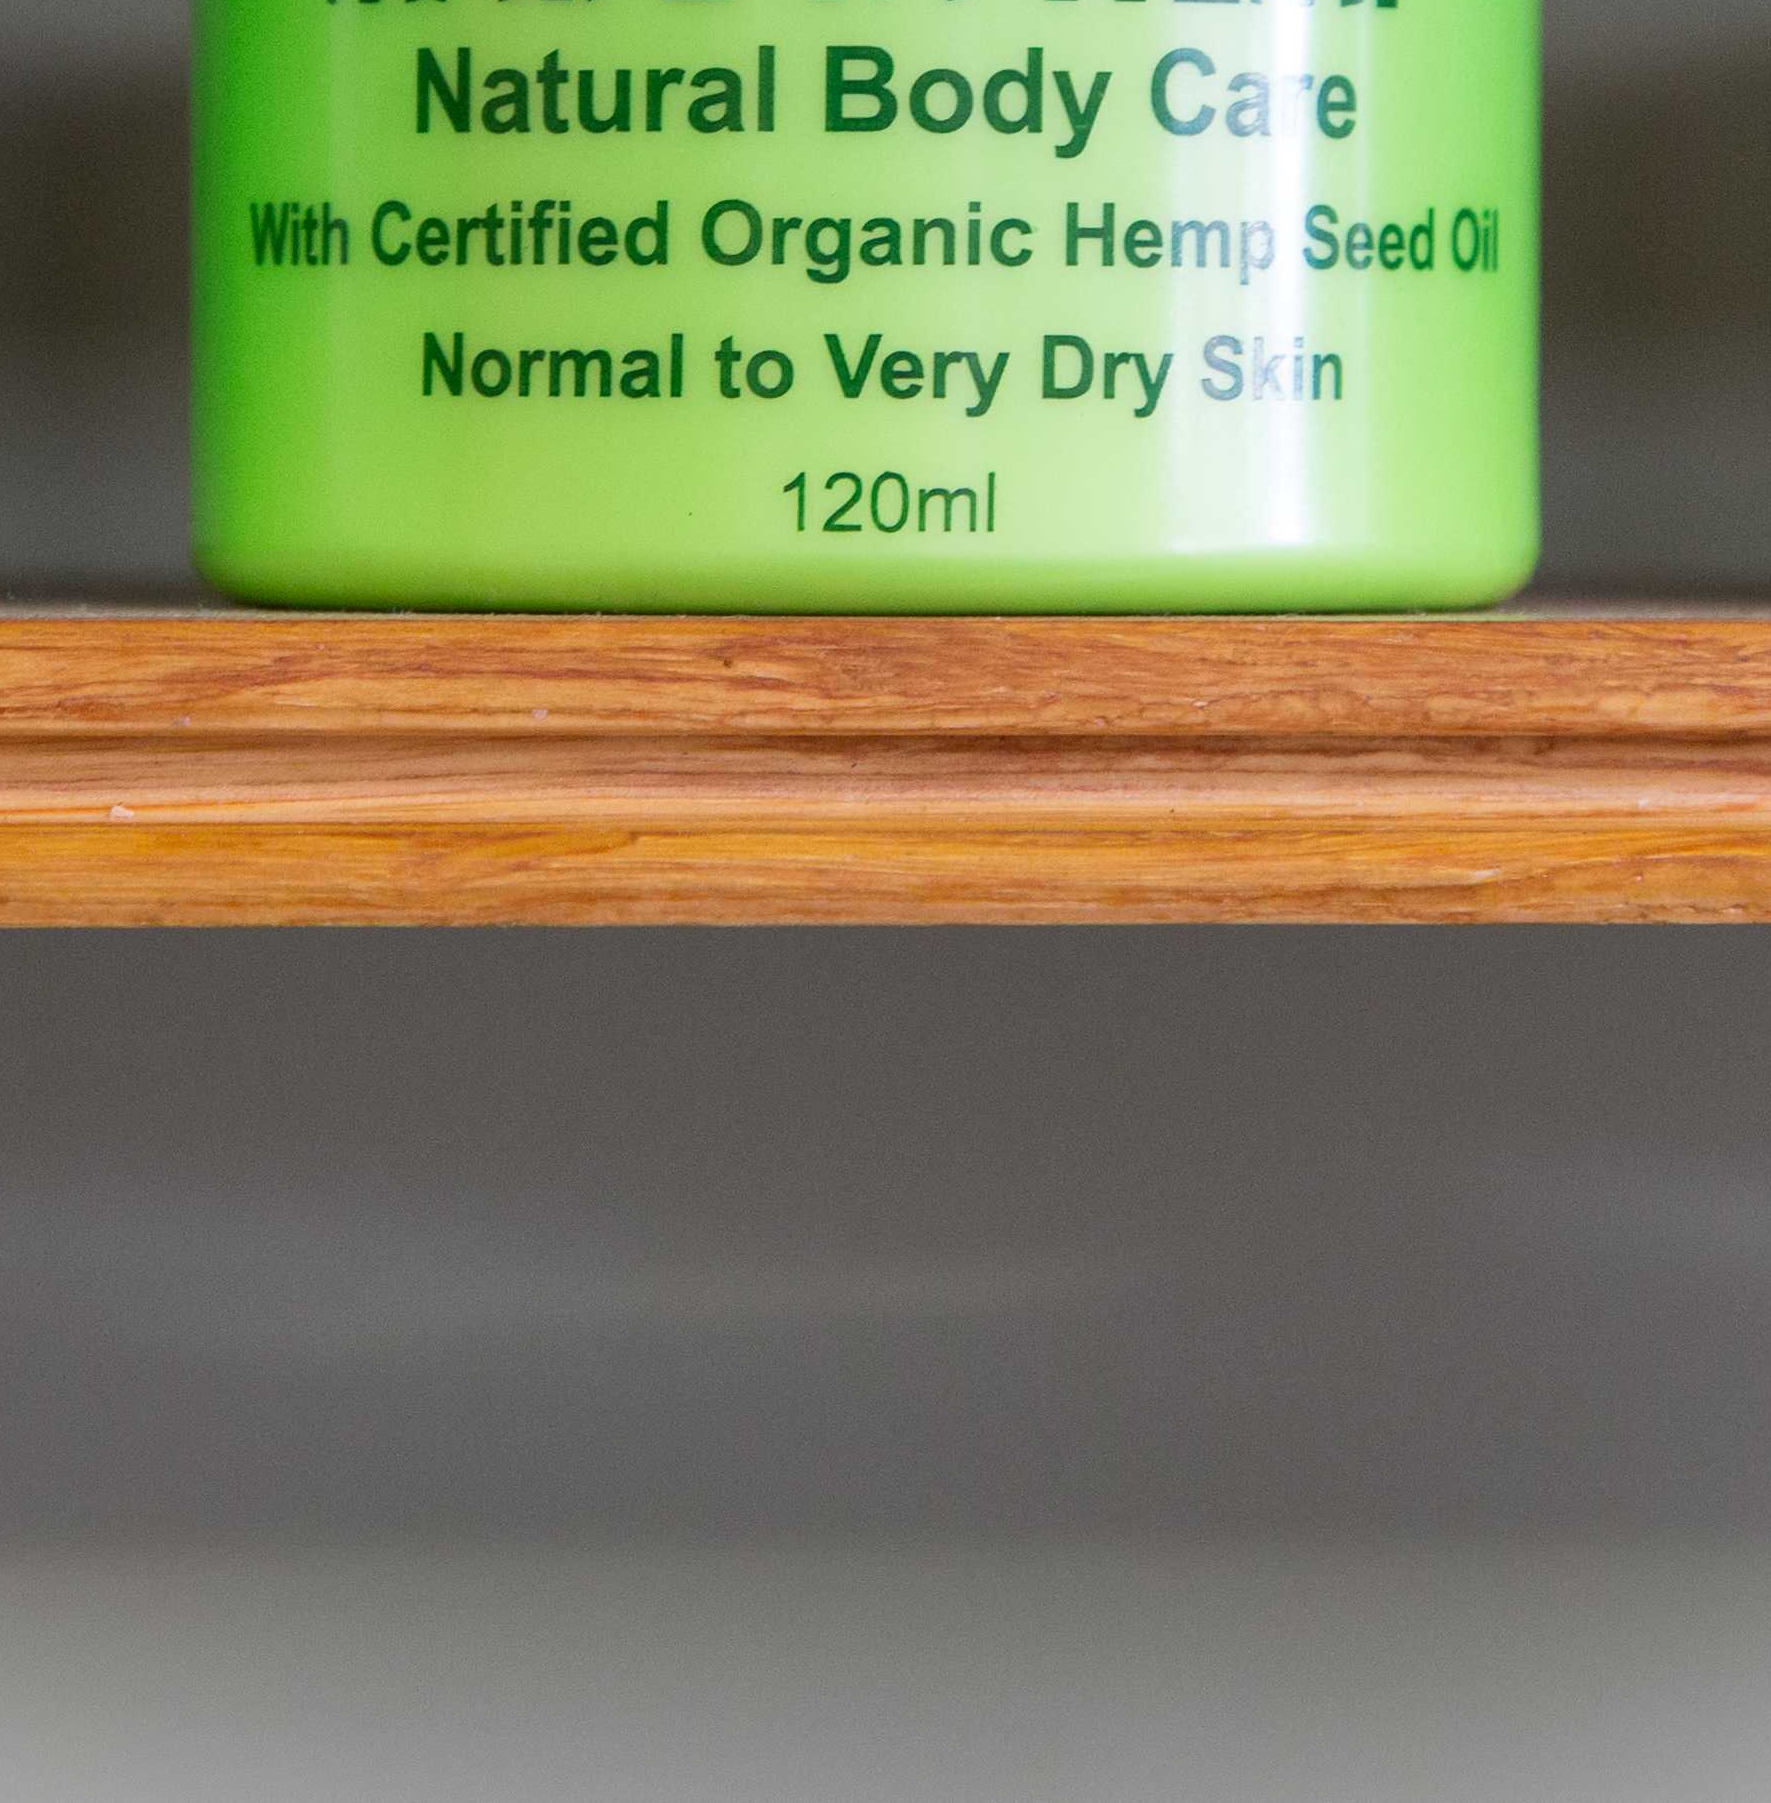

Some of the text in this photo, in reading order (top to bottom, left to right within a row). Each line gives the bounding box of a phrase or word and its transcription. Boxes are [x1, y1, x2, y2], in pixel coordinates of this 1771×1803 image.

[415, 44, 1358, 160] Natural Body Care
[249, 198, 1499, 286] With Certified Organic Hemp Seed Oil
[421, 329, 1343, 419] Normal to Very Dry Skin
[783, 470, 996, 534] 120ml
